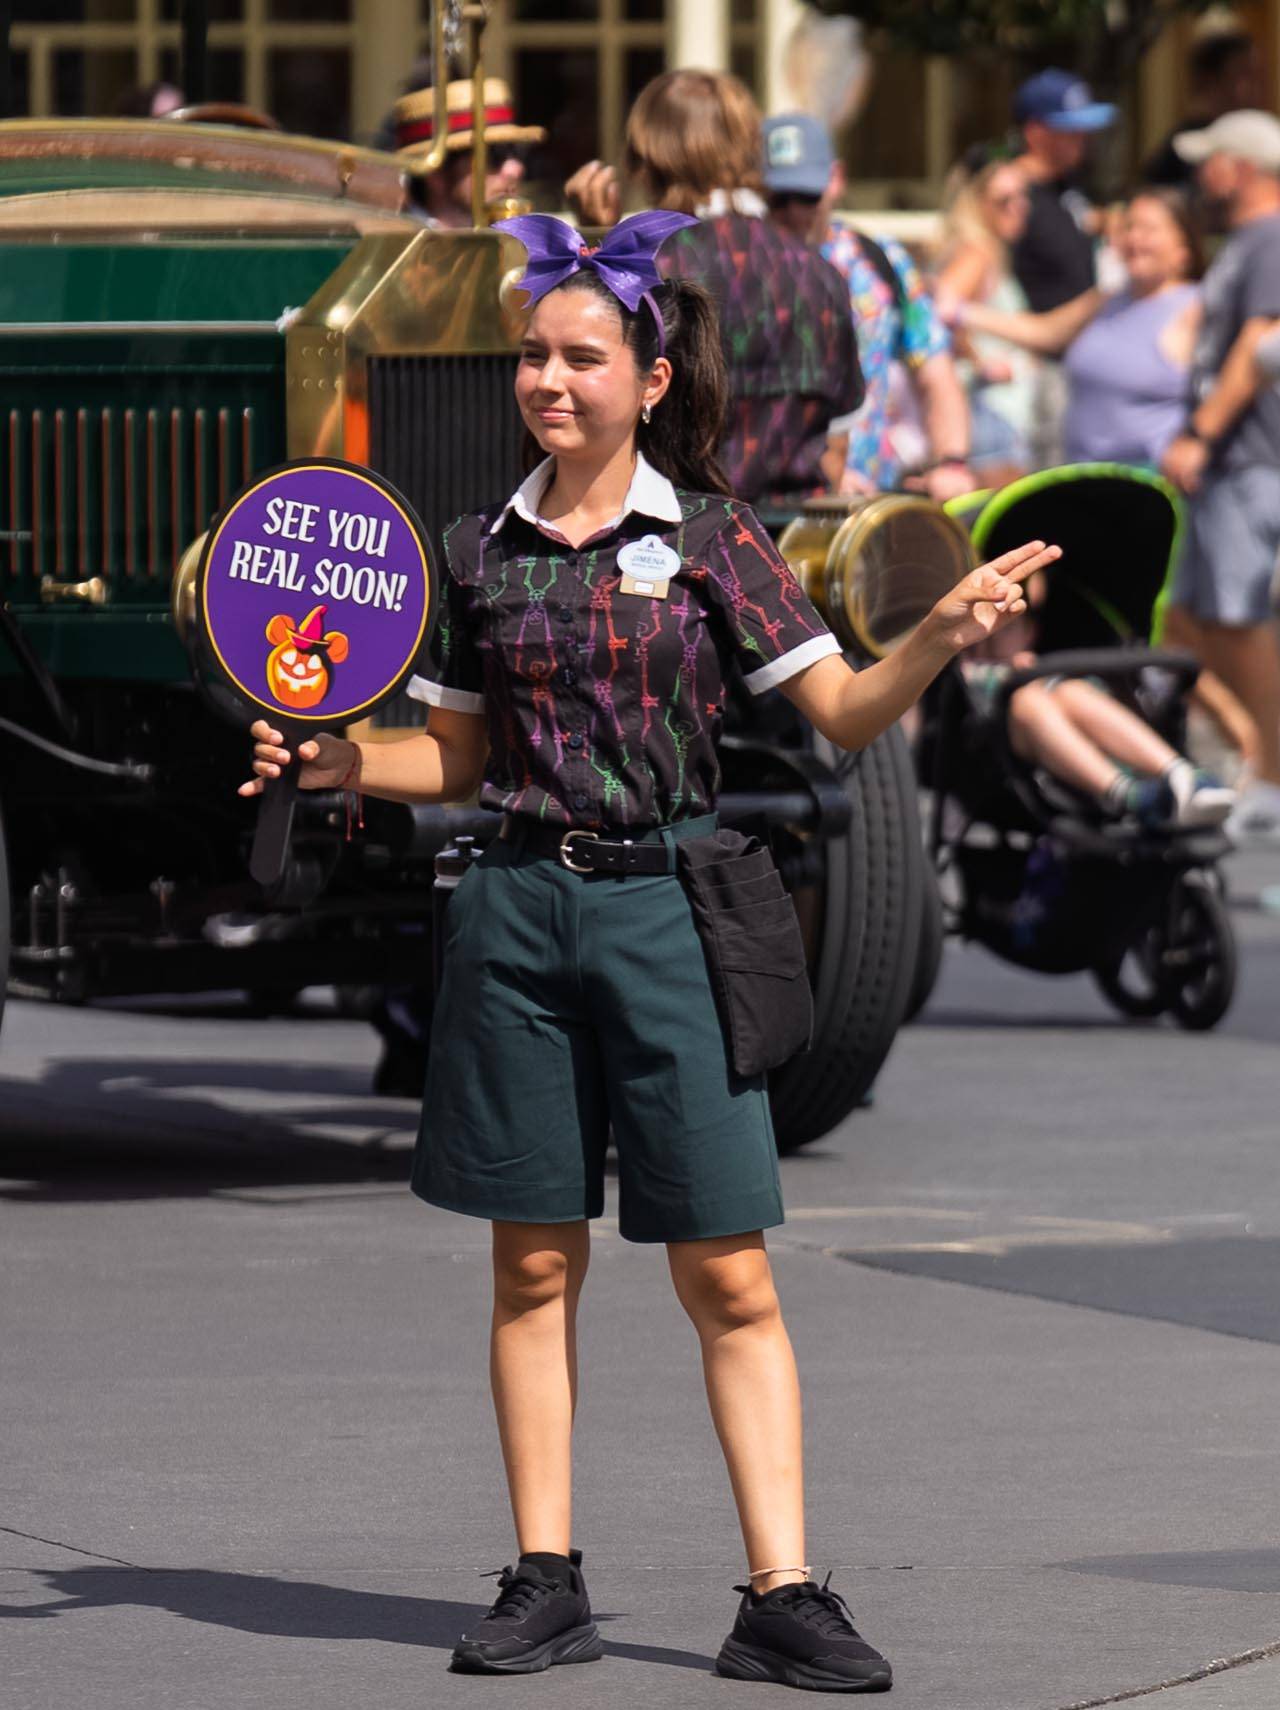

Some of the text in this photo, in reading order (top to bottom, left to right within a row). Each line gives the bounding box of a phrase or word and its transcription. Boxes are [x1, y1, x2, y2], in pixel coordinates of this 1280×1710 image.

[262, 497, 391, 557] SEE YOU
[228, 541, 408, 612] REAL SOON!
